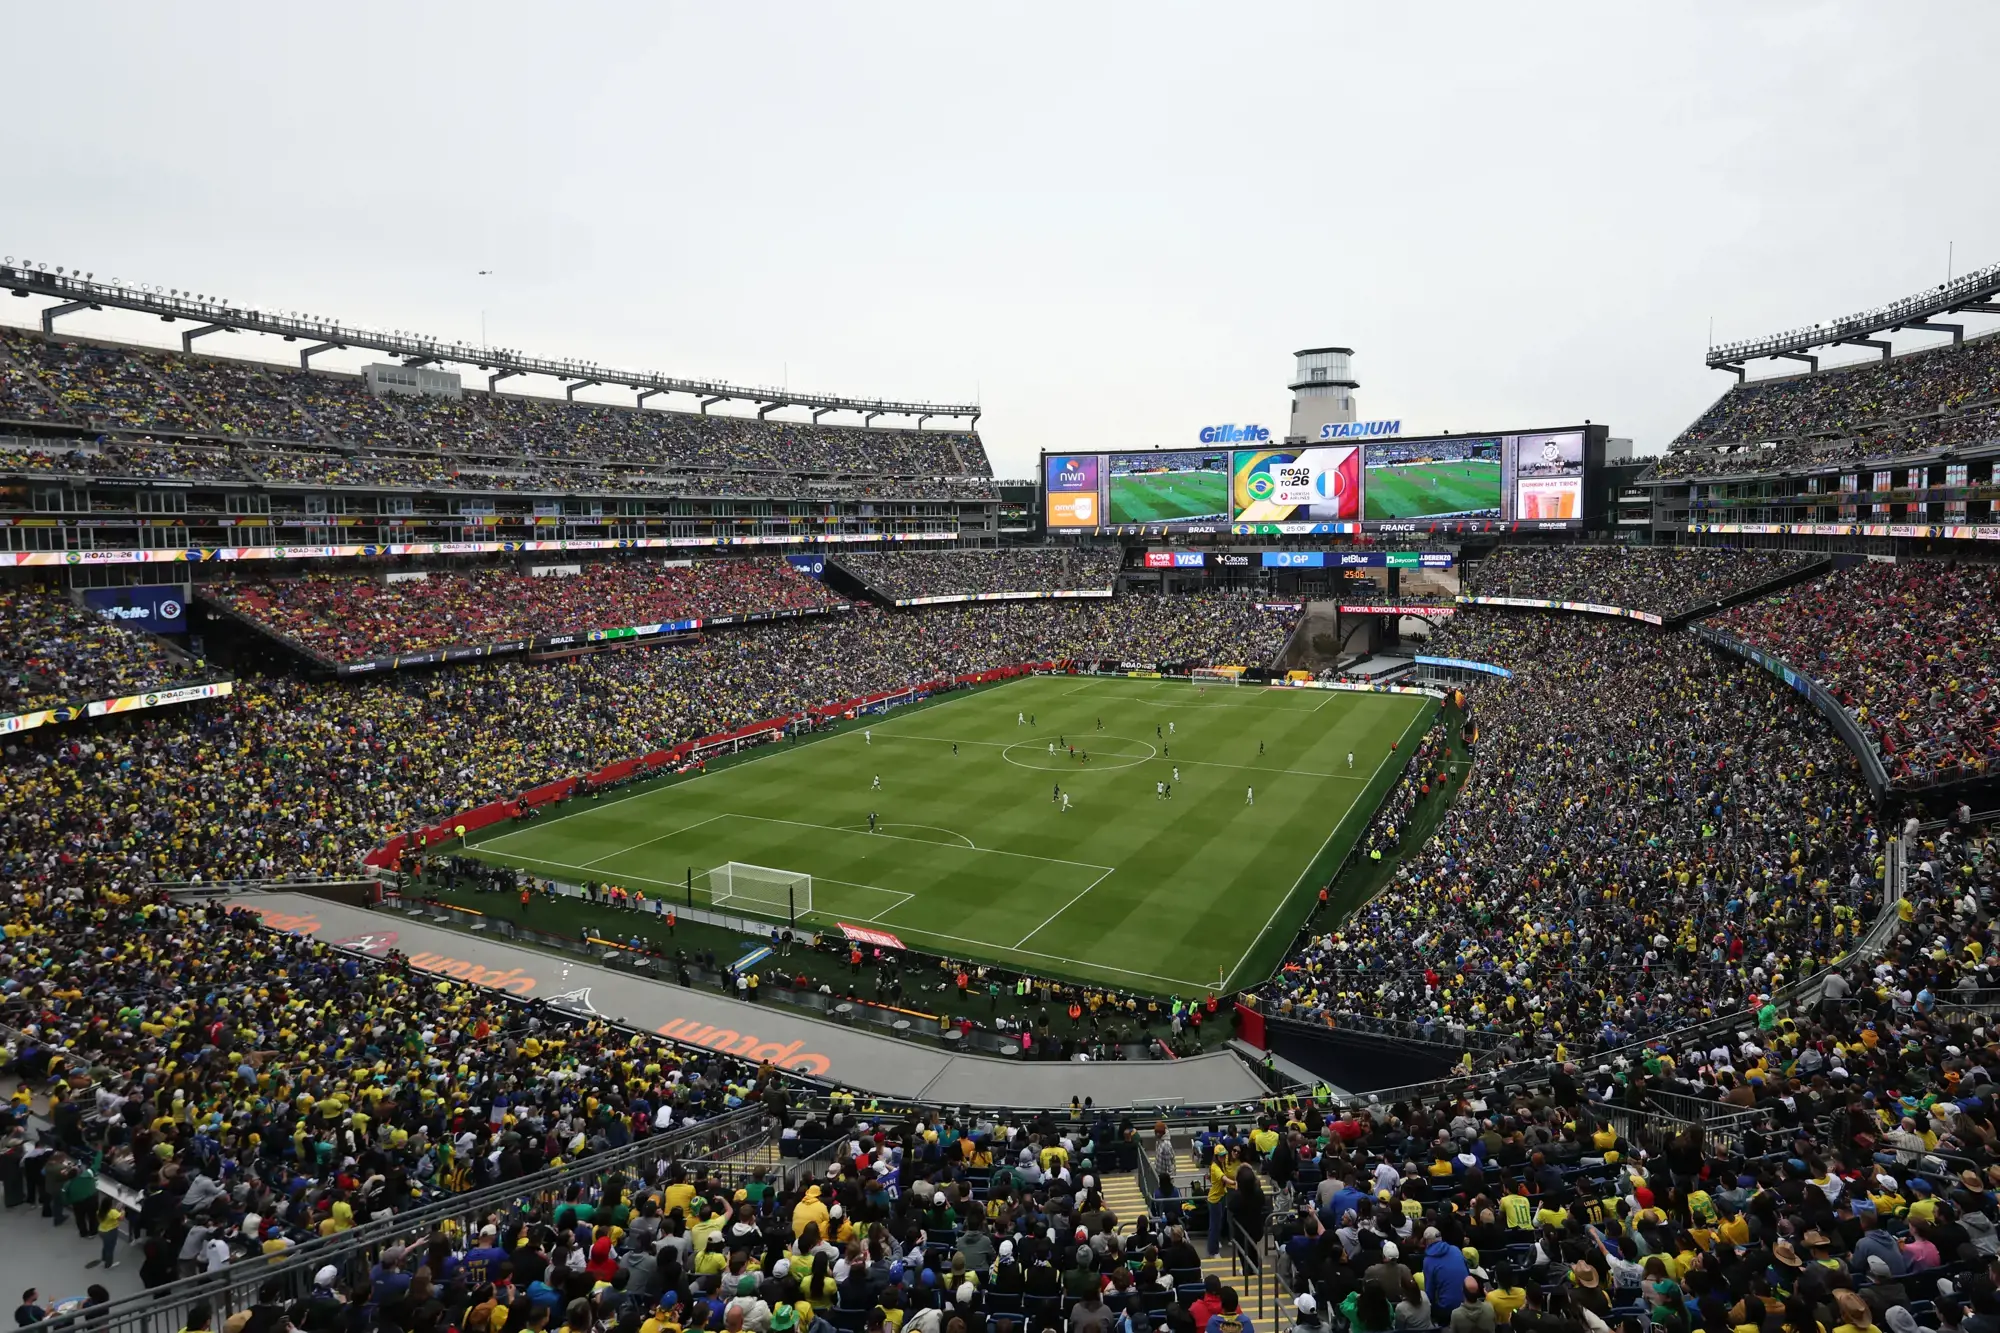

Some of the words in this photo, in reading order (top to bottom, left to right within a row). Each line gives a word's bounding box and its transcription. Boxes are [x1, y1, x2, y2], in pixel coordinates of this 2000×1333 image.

[1200, 425, 1270, 443] Gillette
[1321, 421, 1400, 438] STADIUM
[1060, 472, 1085, 481] nwn
[1280, 468, 1310, 476] ROAD
[1291, 476, 1310, 486] 26
[1500, 524, 1505, 532] 2
[1176, 554, 1203, 565] VISA
[1341, 554, 1369, 564] jetBlue
[1344, 570, 1366, 578] 25:06
[550, 636, 574, 645] BRAZIL
[518, 642, 524, 650] 2
[475, 647, 482, 656] 0
[400, 656, 424, 665] CORNERS
[429, 654, 434, 662] 1
[161, 690, 184, 700] ROAD
[190, 687, 200, 695] 26
[1513, 1204, 1530, 1224] 10
[1586, 1206, 1602, 1224] 10
[470, 1267, 487, 1282] 10
